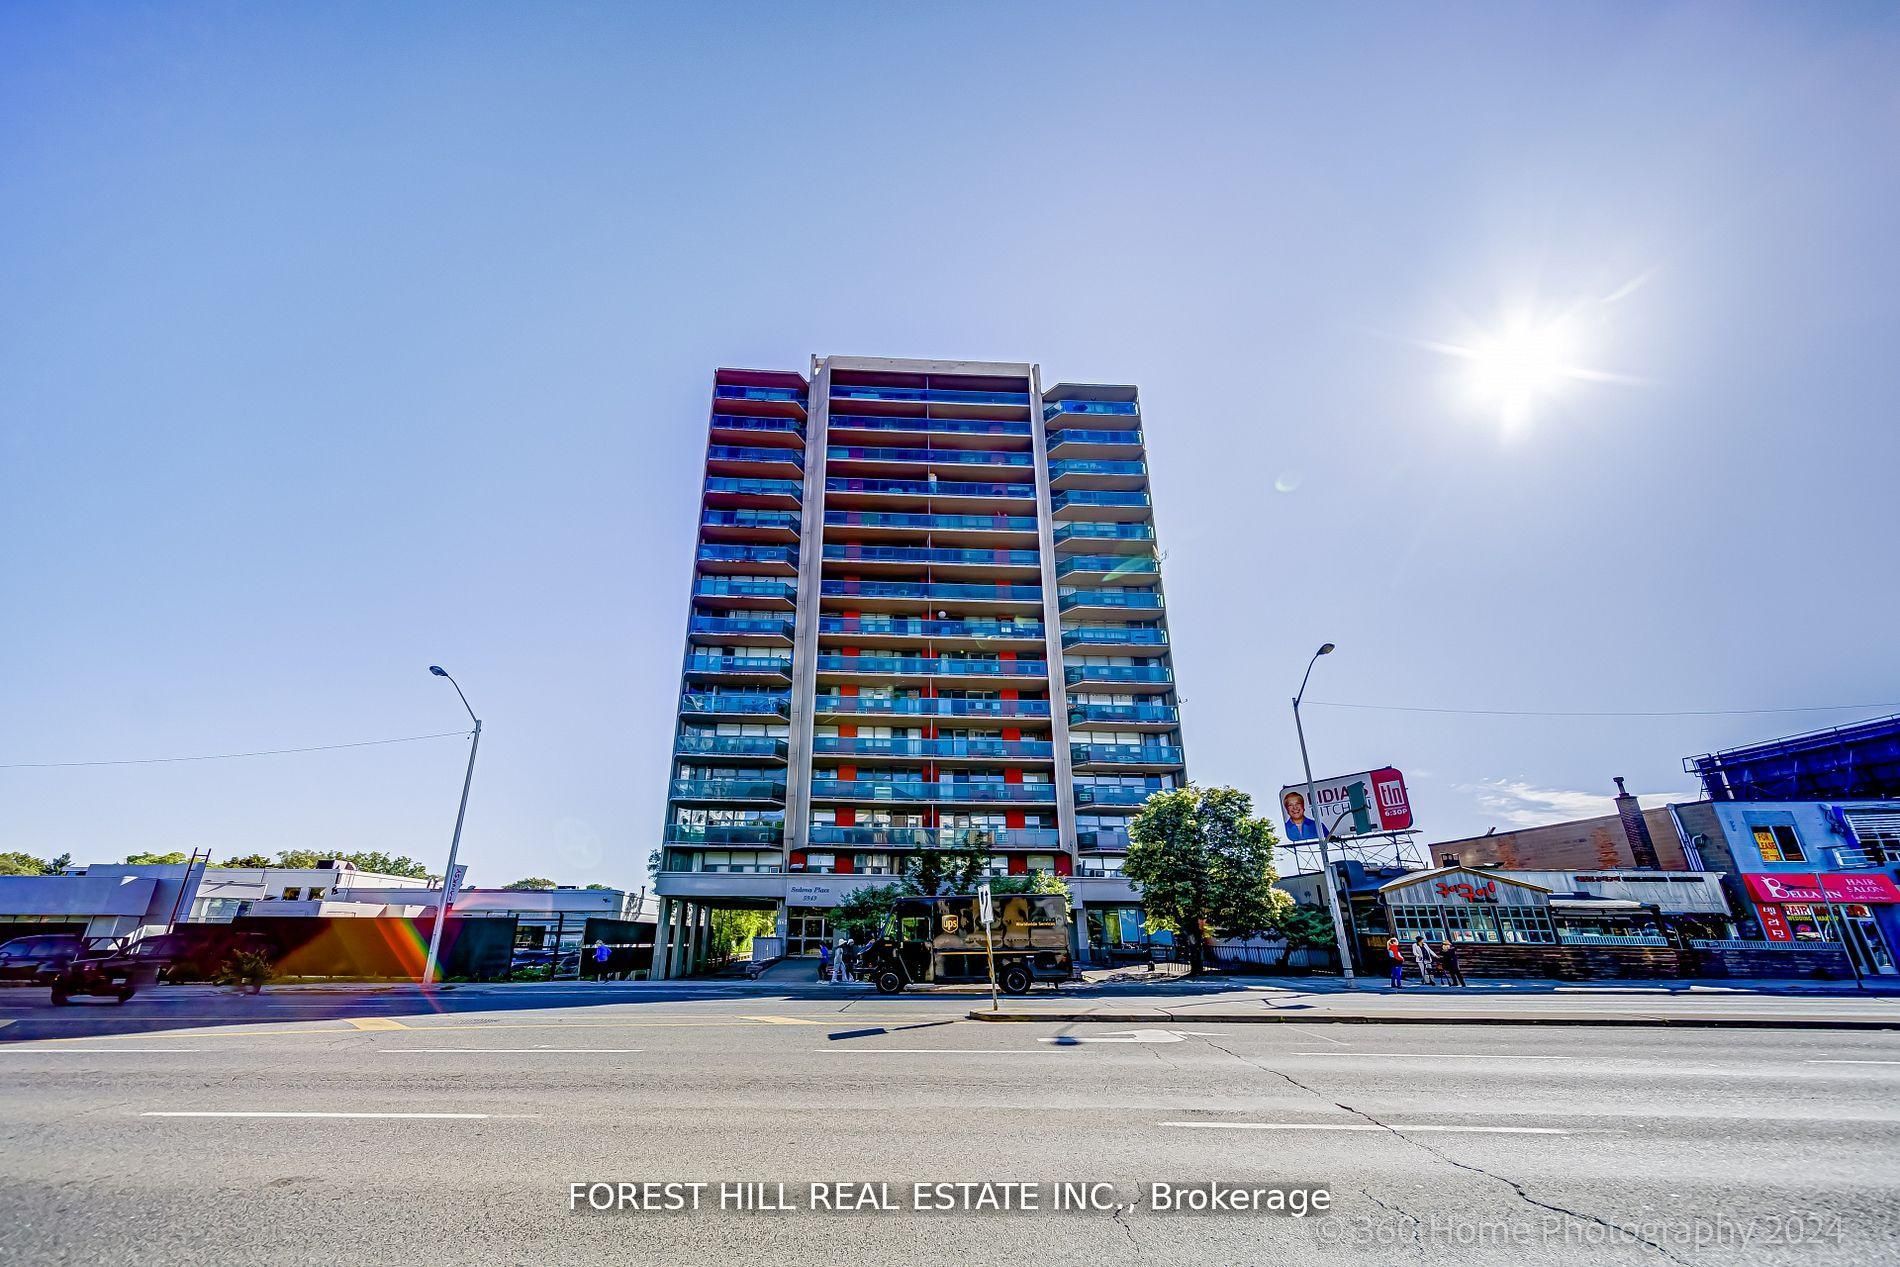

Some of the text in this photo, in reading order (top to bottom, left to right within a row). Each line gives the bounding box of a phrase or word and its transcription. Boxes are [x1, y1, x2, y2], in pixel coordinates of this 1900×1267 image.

[1307, 786, 1369, 806] LIDIA
[1311, 799, 1371, 818] ITCH
[1845, 878, 1877, 886] HAIR
[1785, 905, 1811, 915] HAIR
[943, 919, 957, 930] ups
